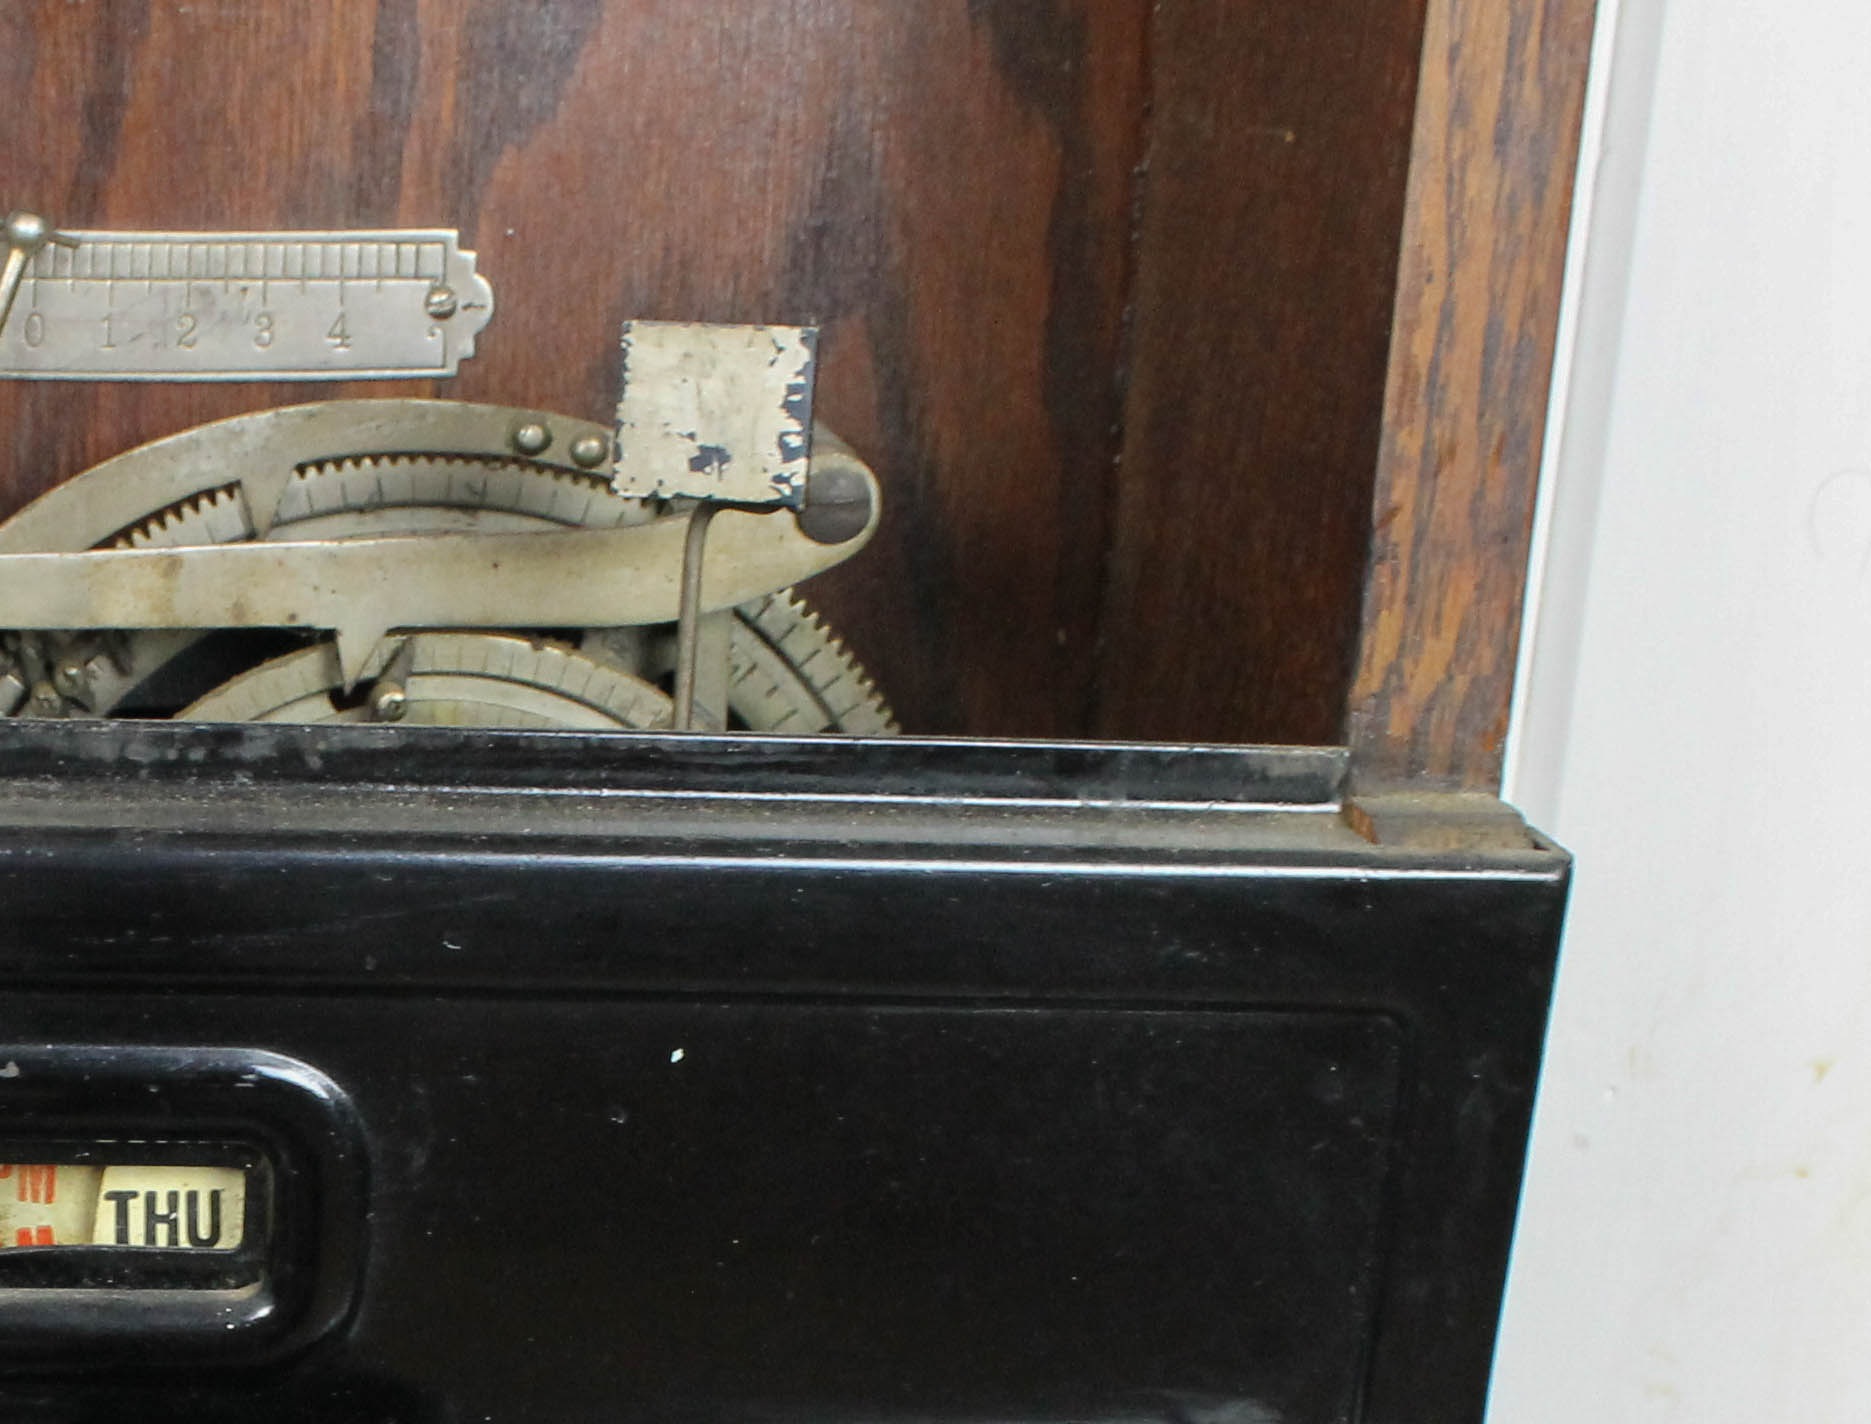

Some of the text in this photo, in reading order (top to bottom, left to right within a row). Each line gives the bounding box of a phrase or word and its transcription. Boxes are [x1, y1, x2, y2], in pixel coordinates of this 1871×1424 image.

[23, 312, 45, 349] 0
[99, 313, 118, 350] 1
[176, 312, 199, 350] 2
[253, 312, 276, 350] 3
[326, 311, 352, 352] 4
[103, 1189, 224, 1248] THU
